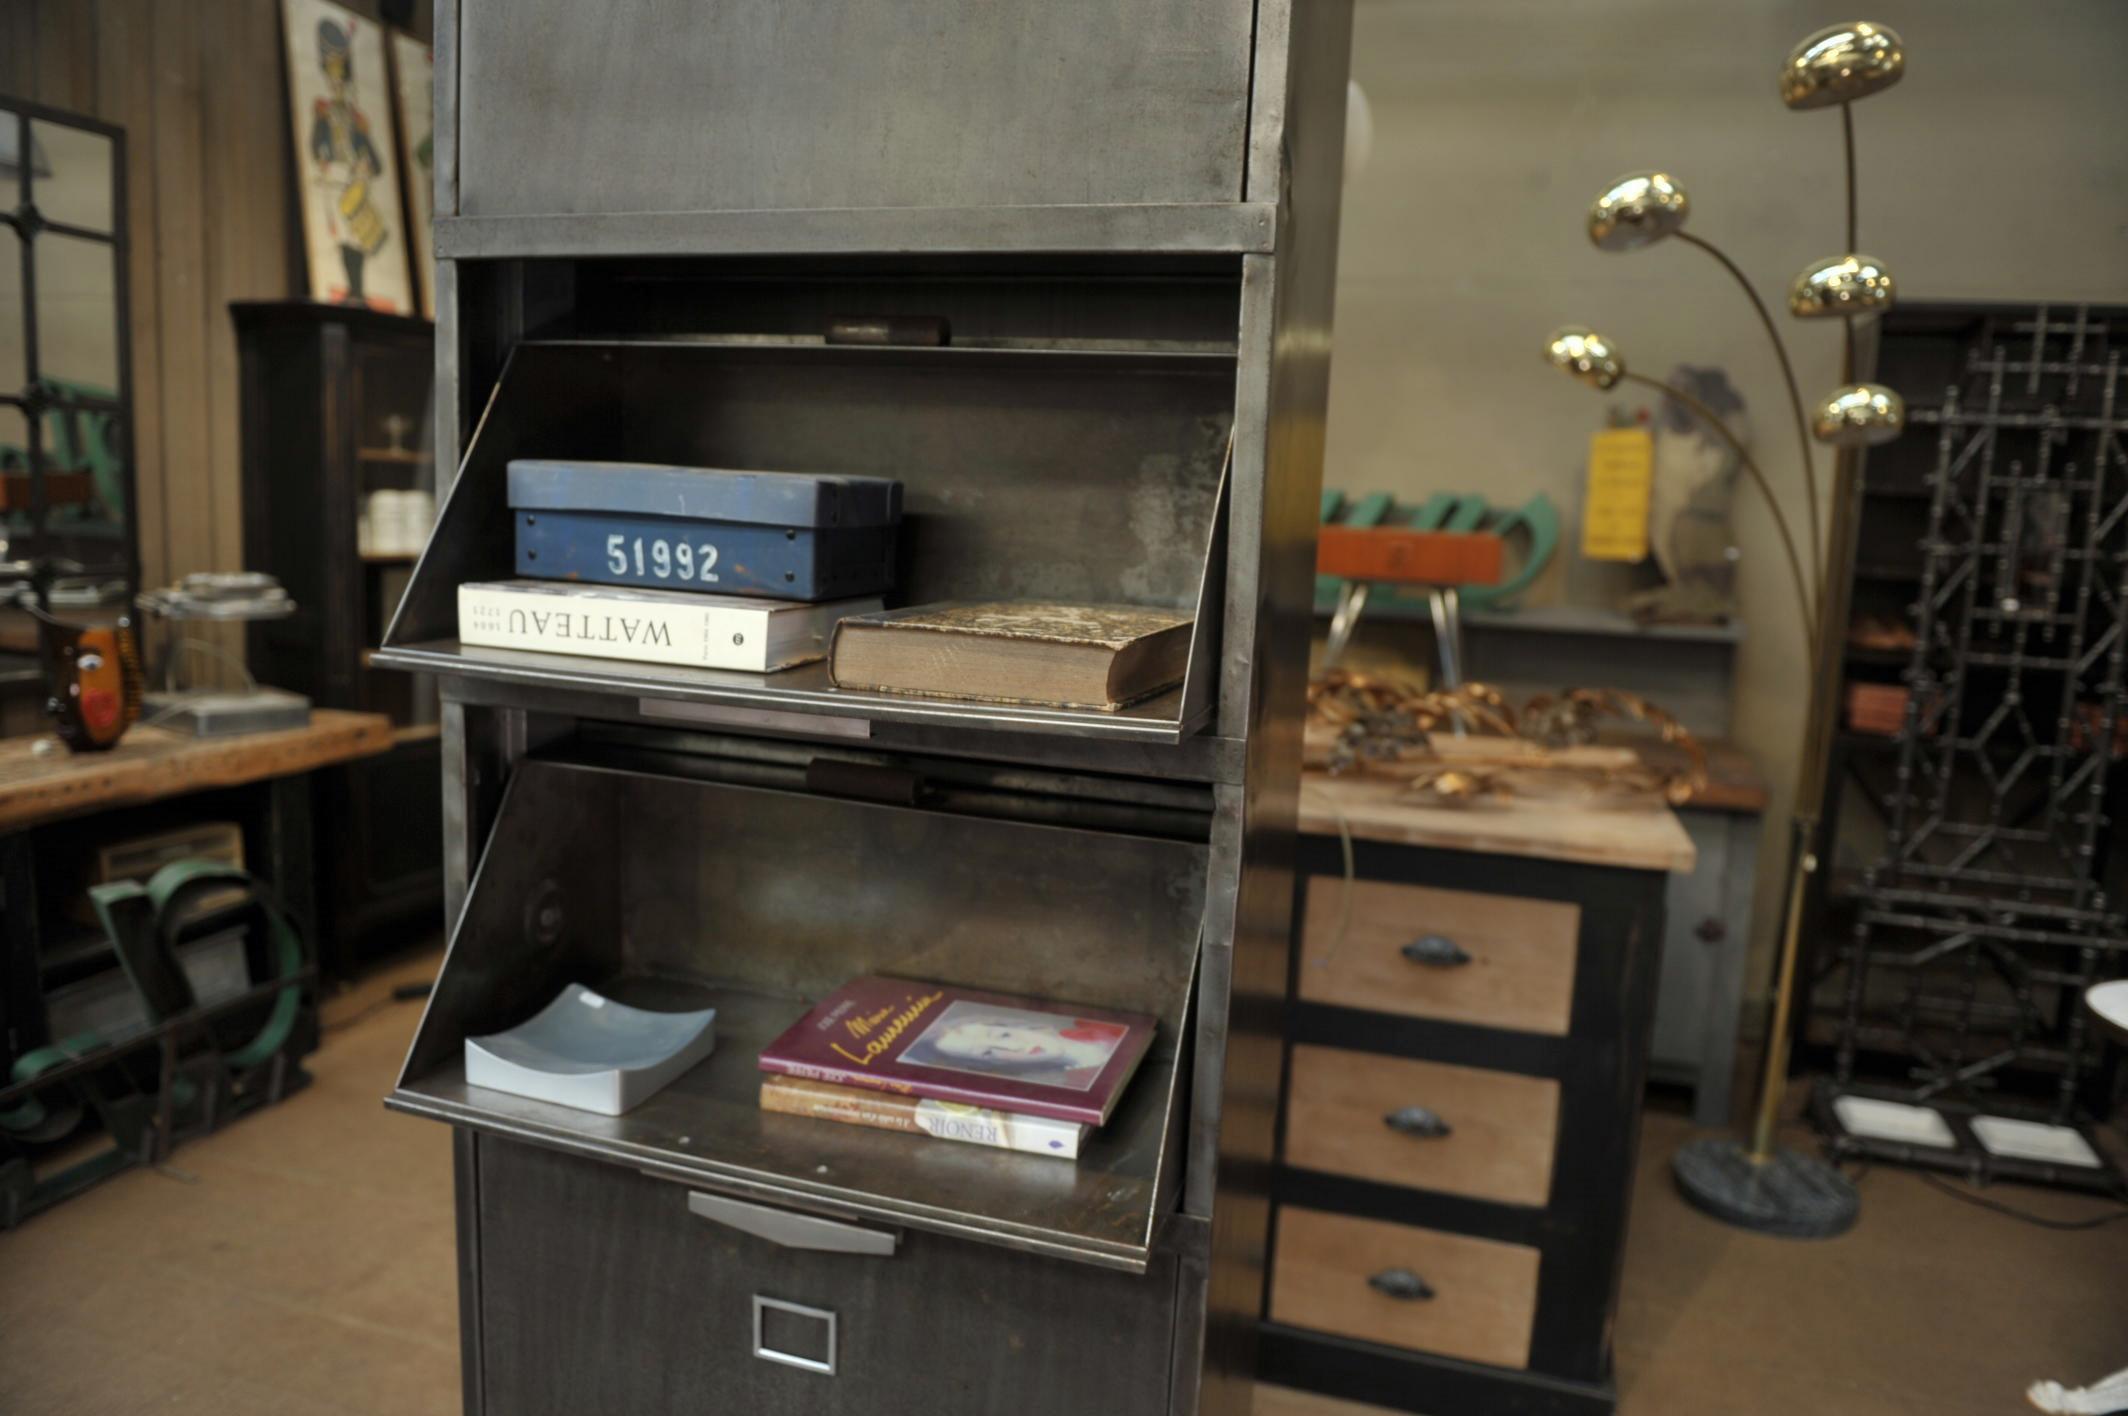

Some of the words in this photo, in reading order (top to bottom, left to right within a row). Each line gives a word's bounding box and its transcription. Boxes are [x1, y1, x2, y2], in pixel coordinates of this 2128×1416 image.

[607, 535, 719, 582] 51992
[509, 609, 672, 646] WATTEAU
[929, 1118, 998, 1142] RENOIR
